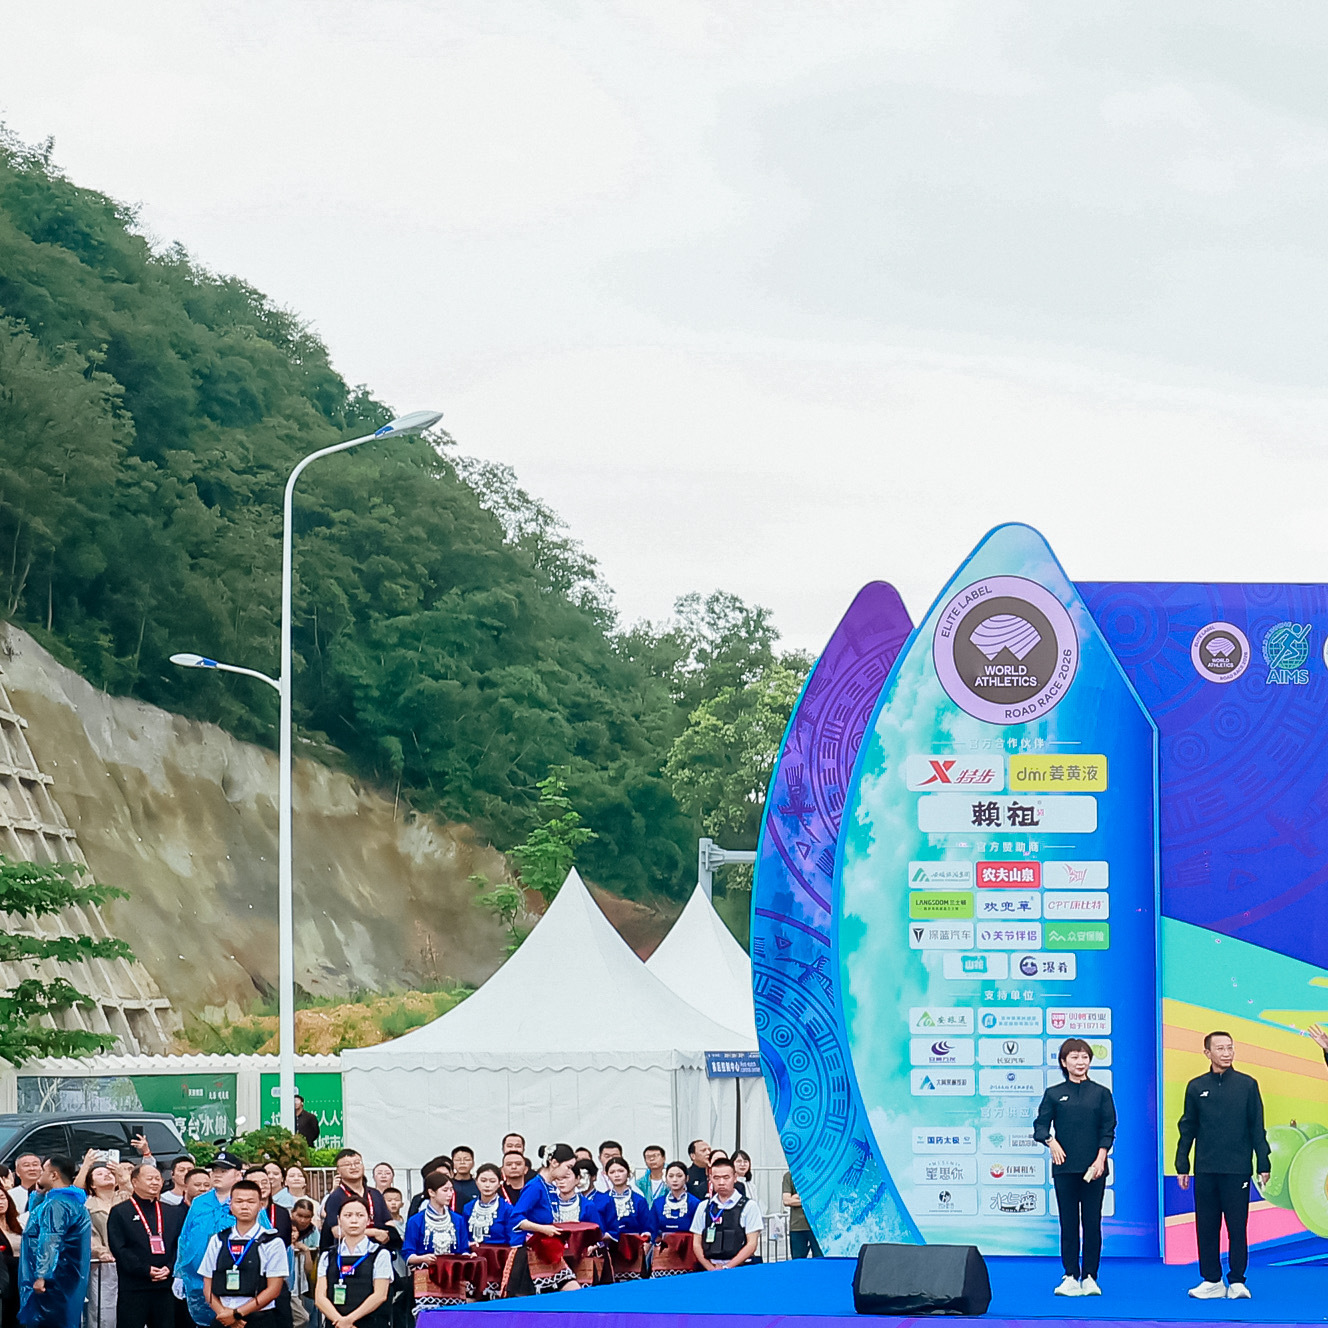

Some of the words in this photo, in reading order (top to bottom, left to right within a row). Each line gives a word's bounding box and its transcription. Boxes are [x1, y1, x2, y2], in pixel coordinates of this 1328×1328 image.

[941, 607, 961, 638] ELITE
[958, 585, 993, 612] LABEL
[984, 665, 1027, 676] WORLD
[1266, 669, 1309, 685] AIMS
[974, 676, 1038, 687] ATHLETICS
[1004, 703, 1037, 718] ROAD
[1036, 683, 1063, 708] RACE
[1059, 648, 1072, 682] 2026
[1049, 764, 1098, 782] 姜黄液
[982, 868, 1034, 882] 农夫山泉
